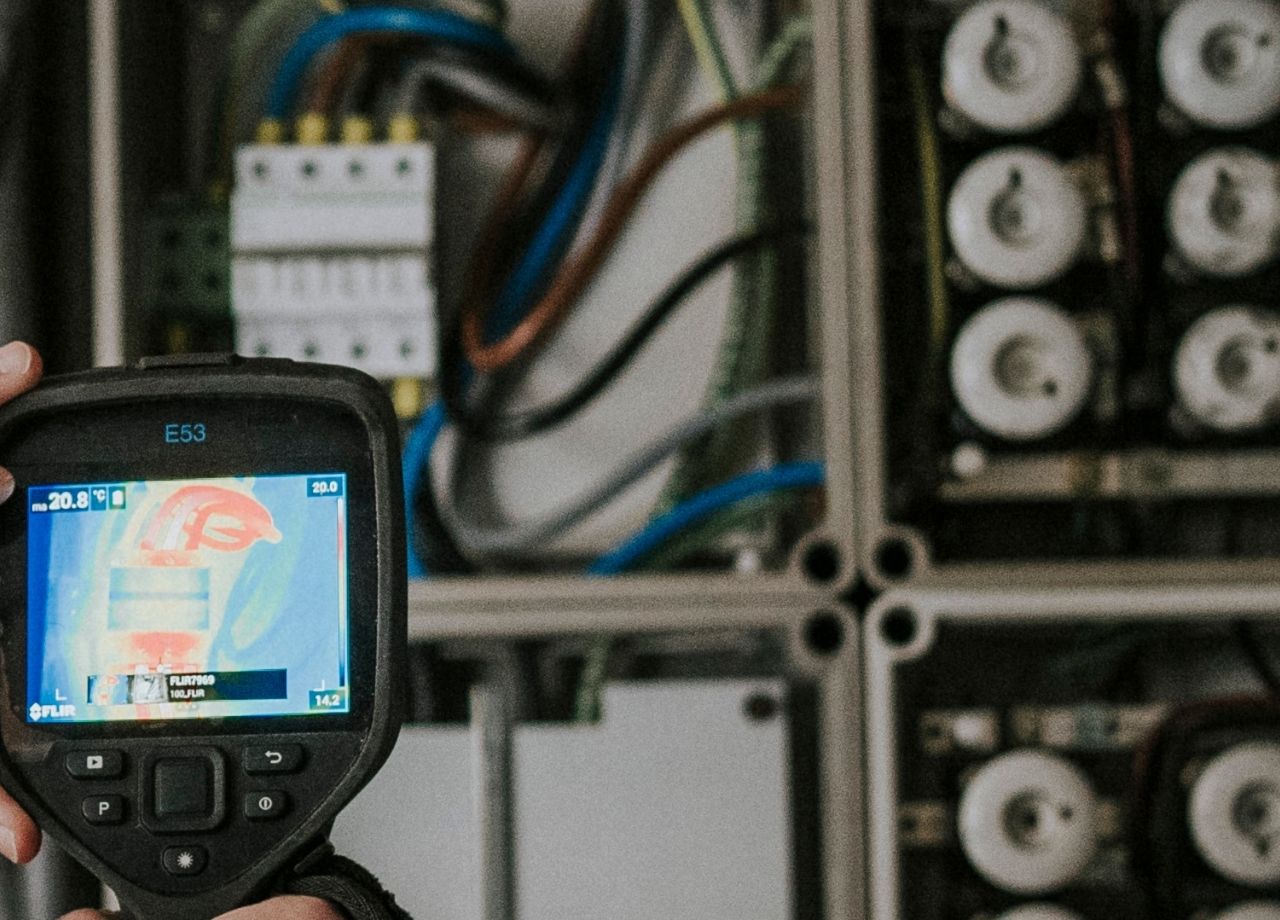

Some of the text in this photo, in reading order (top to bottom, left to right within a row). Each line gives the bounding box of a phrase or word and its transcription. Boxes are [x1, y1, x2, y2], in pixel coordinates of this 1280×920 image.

[165, 423, 206, 442] E53
[48, 491, 89, 510] 20.8
[315, 694, 340, 706] 14.2
[41, 704, 76, 718] FLIR
[99, 801, 110, 816] P
